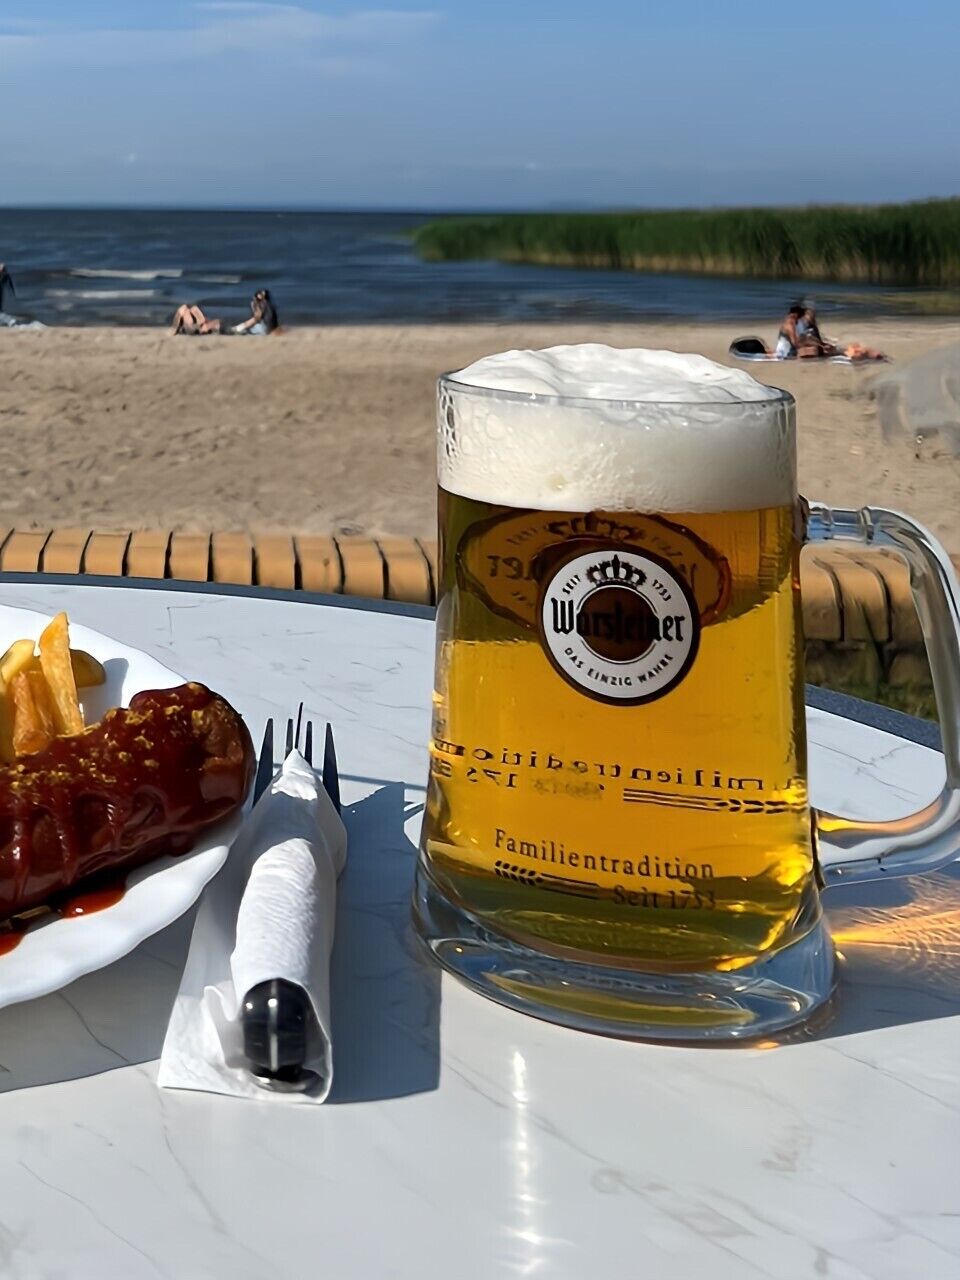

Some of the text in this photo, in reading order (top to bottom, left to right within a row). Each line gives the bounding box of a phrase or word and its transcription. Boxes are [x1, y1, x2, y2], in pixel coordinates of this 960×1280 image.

[550, 597, 686, 645] Warsteiner
[564, 647, 585, 669] DAS
[587, 668, 633, 686] EINZIG
[494, 828, 715, 879] Familientradition
[613, 884, 659, 909] Seit
